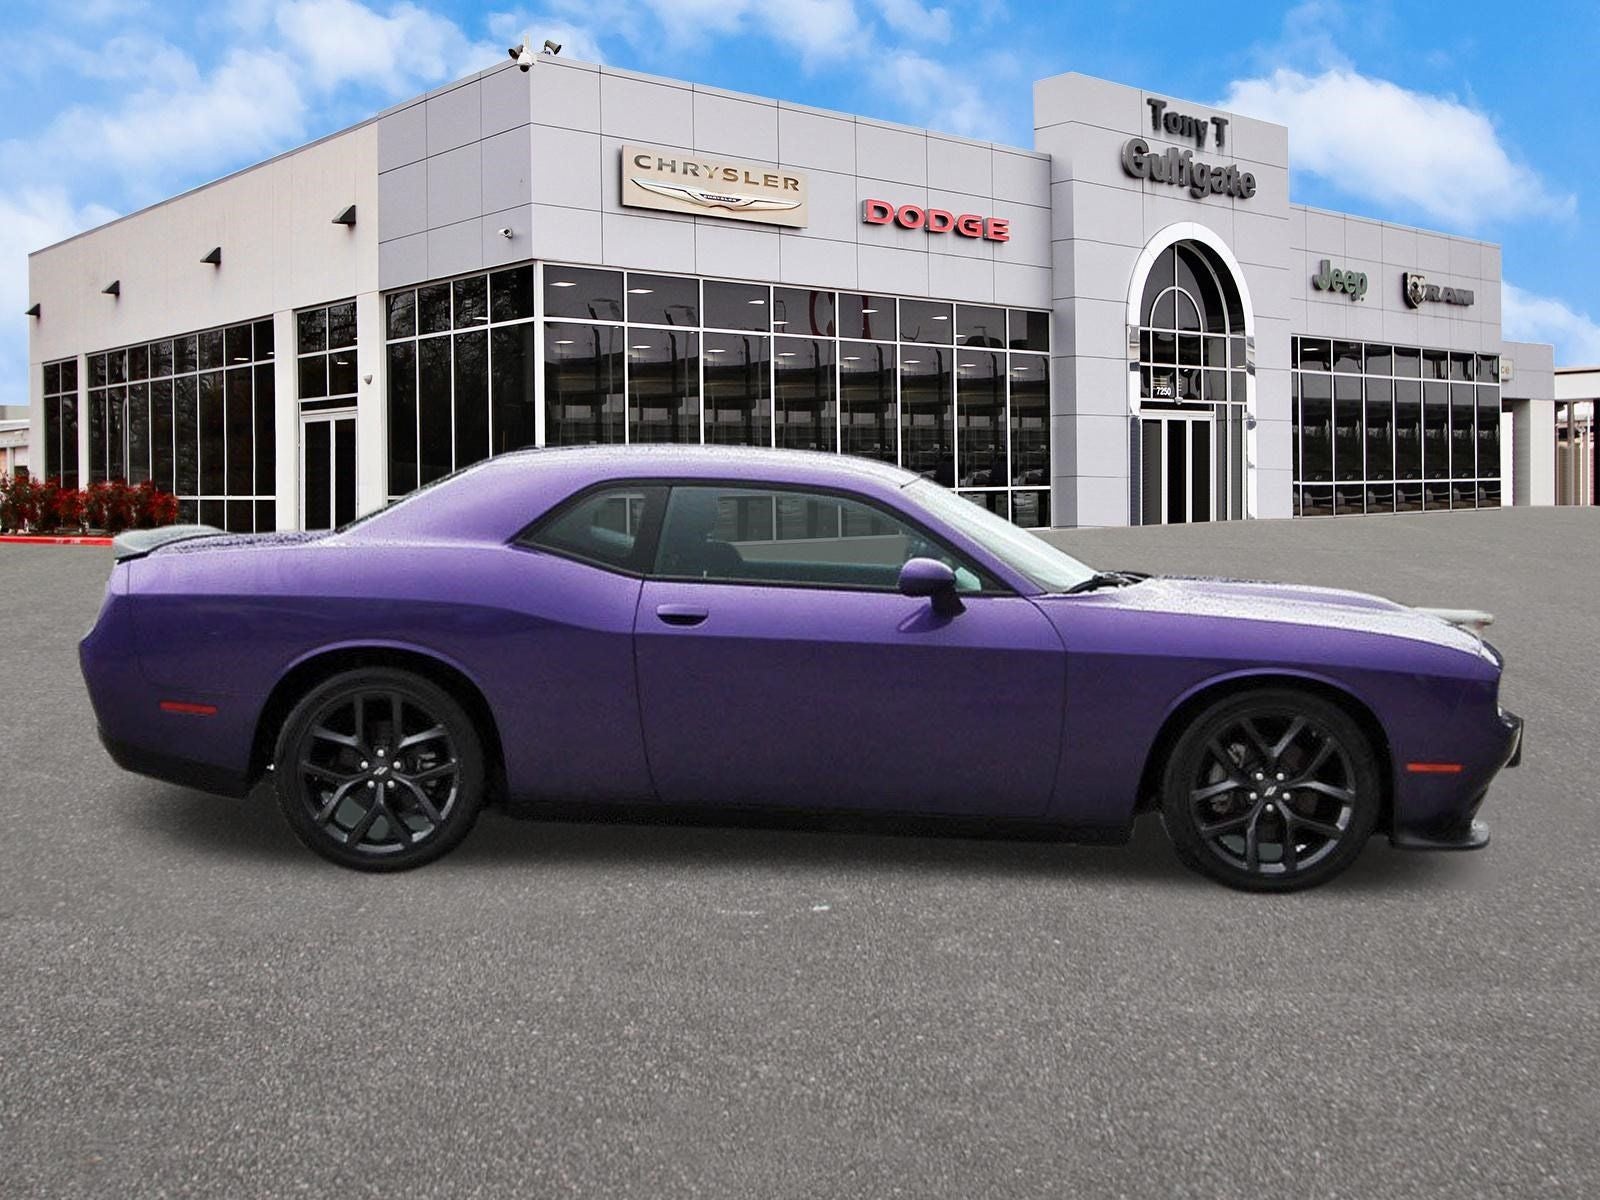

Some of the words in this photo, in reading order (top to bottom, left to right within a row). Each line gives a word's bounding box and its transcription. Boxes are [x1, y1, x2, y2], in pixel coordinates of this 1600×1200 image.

[1146, 98, 1208, 147] Tony
[1210, 116, 1229, 147] T
[633, 154, 800, 192] CHRYSLER
[1121, 138, 1257, 199] Gulfgate
[861, 198, 1011, 242] DODGE
[1425, 284, 1475, 307] RAM
[1156, 386, 1171, 396] 7250
